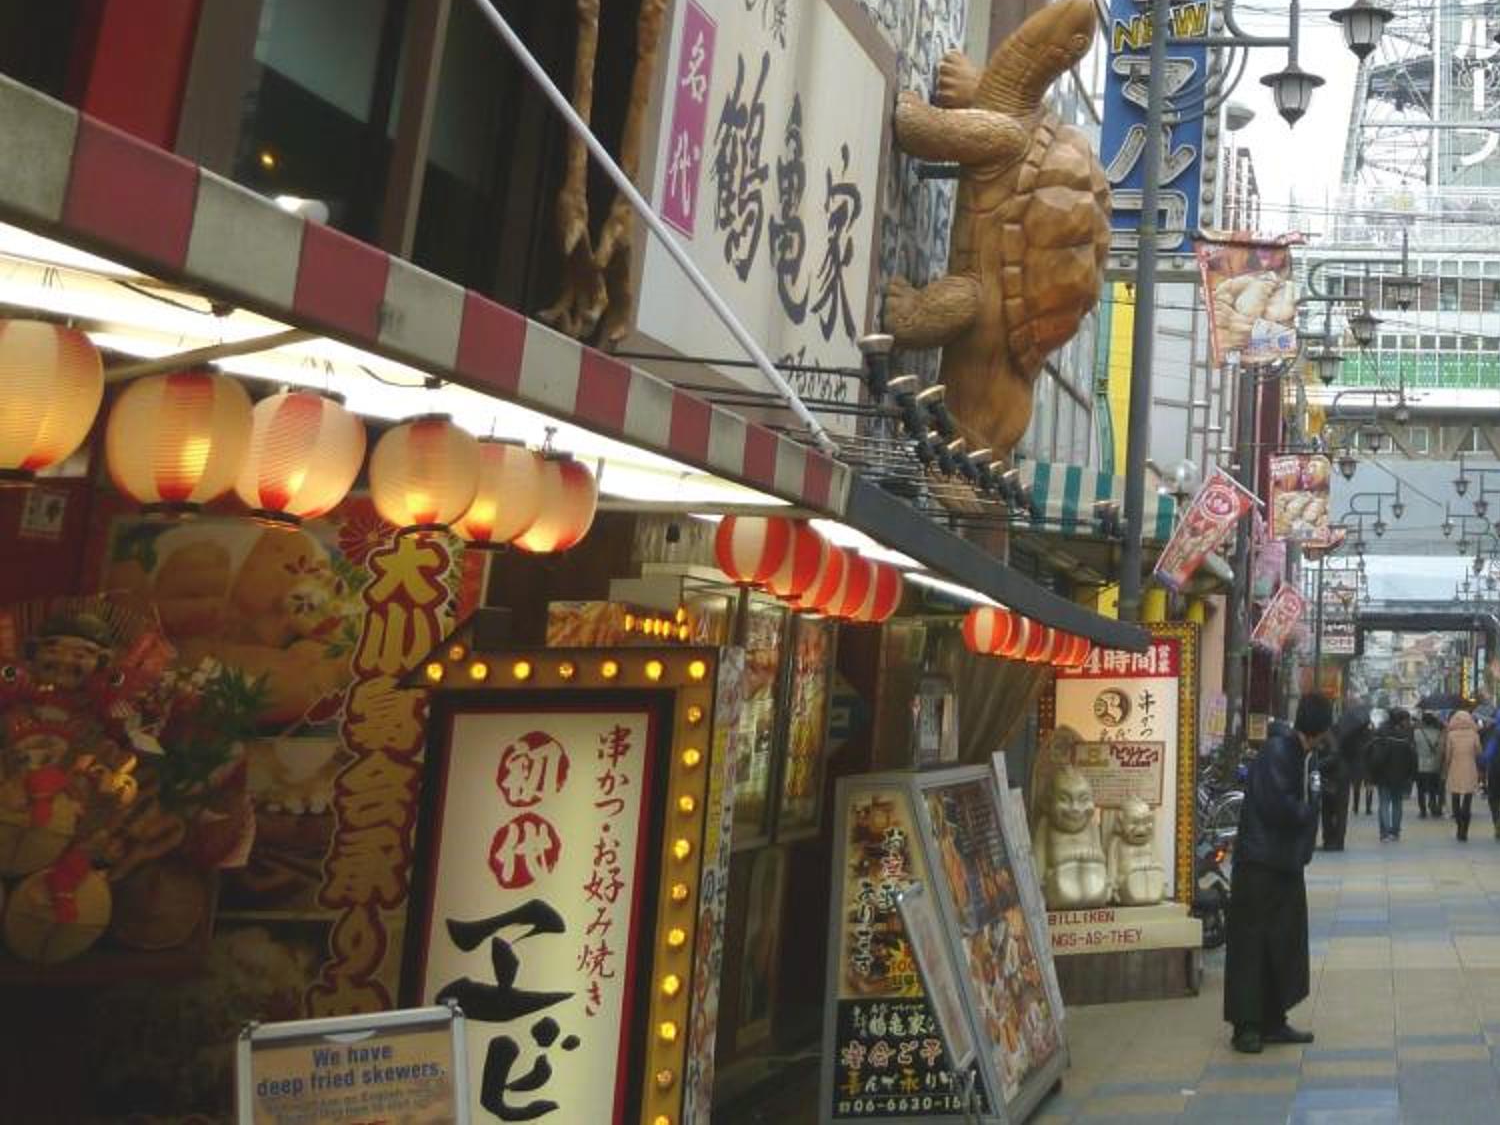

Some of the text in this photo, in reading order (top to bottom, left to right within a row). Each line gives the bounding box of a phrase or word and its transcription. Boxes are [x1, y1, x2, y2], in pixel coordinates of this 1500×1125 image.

[668, 32, 706, 218] 名代
[715, 50, 862, 341] 鶴亀家
[1138, 688, 1157, 738] 串かつ
[488, 731, 569, 890] 初代
[578, 723, 632, 1018] 串かつ・お好み焼き
[1048, 911, 1114, 925] BILLIKEN
[256, 1060, 446, 1098] deep fried skewers.
[313, 1043, 393, 1067] We have
